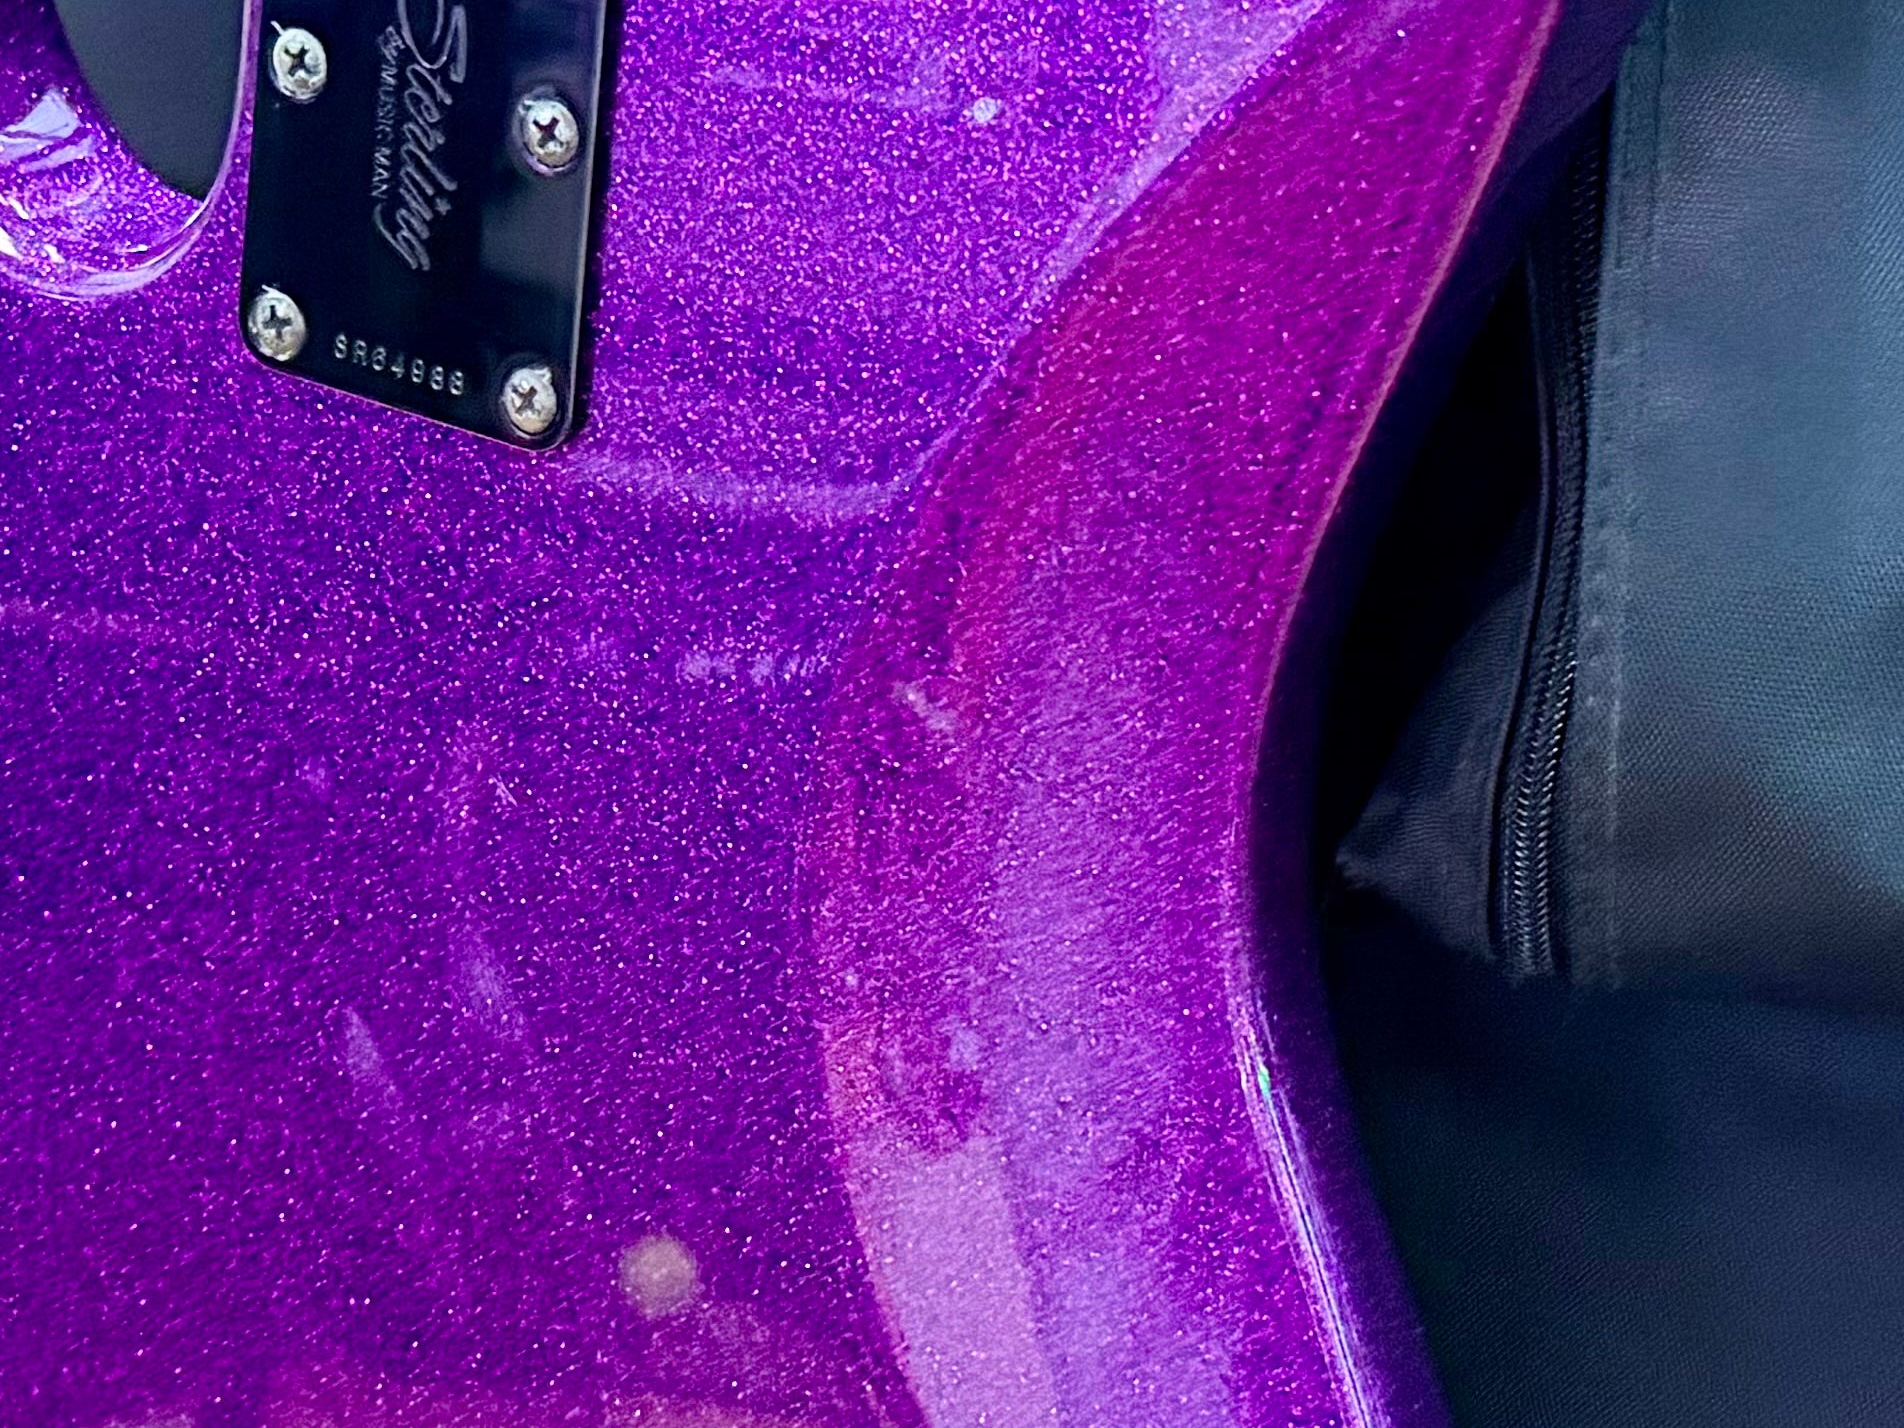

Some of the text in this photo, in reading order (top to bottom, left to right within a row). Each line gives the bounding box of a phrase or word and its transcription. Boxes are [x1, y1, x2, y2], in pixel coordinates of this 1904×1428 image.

[369, 24, 405, 200] by MUSIC MAN
